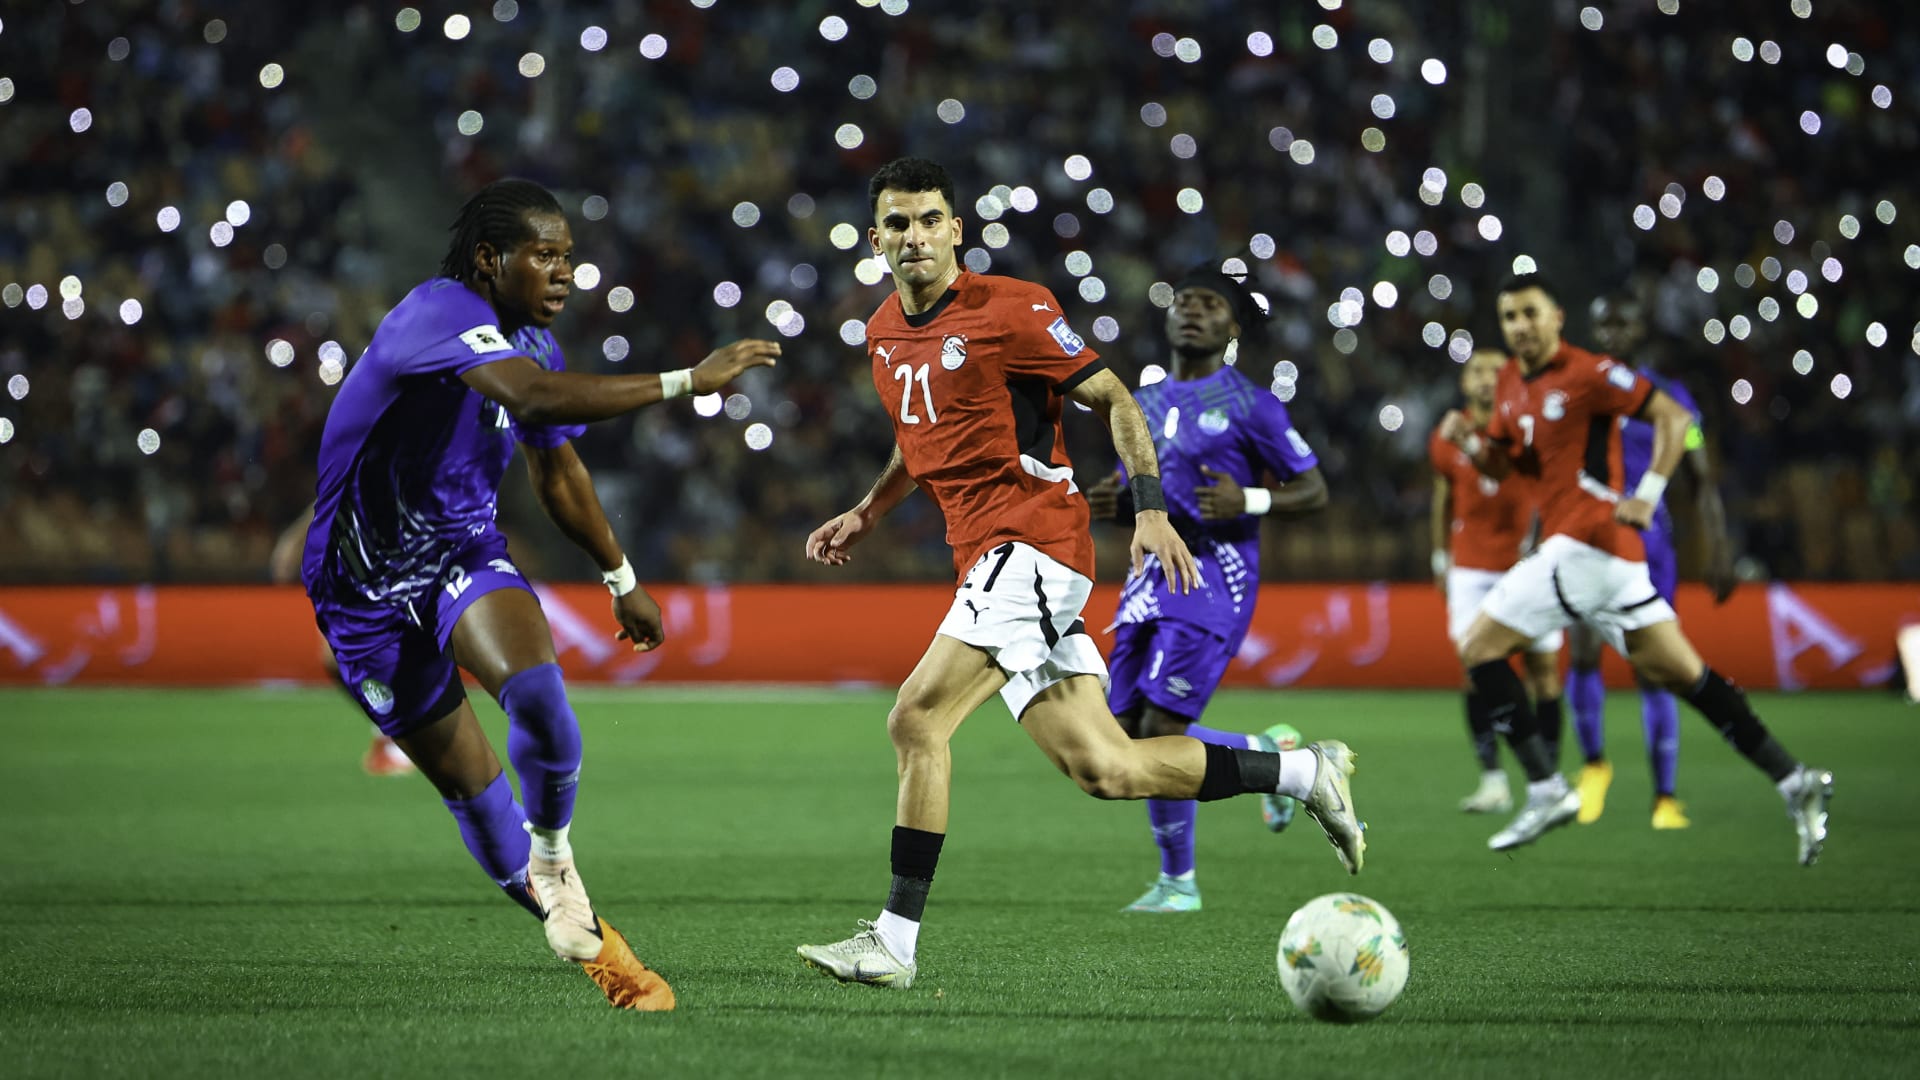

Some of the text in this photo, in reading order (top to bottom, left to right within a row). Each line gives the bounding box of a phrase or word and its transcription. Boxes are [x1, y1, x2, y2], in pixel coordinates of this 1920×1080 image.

[894, 363, 937, 424] 21
[1517, 414, 1535, 446] 7
[441, 565, 473, 600] 12
